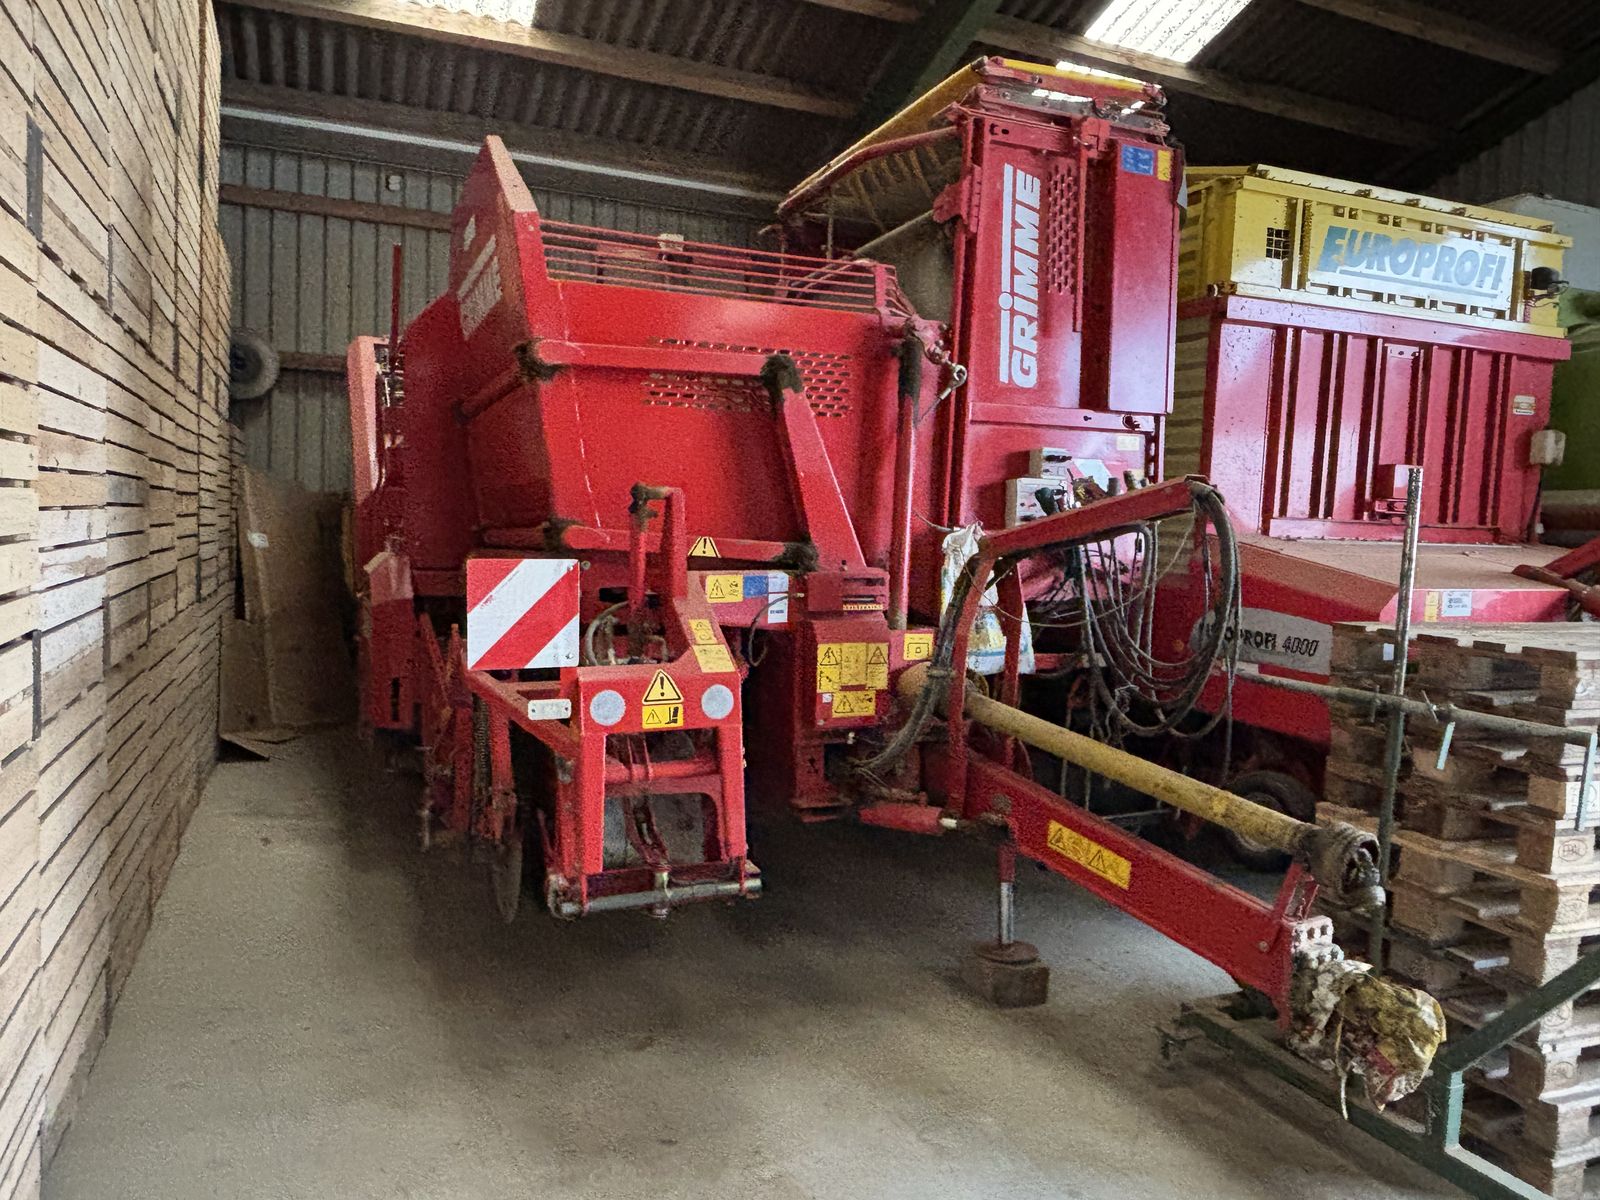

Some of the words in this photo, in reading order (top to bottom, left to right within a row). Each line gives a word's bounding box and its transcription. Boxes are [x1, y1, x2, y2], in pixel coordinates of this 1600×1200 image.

[1000, 165, 1041, 389] GRIMME
[1317, 225, 1507, 290] EUROPROFI
[1282, 635, 1320, 657] 4000
